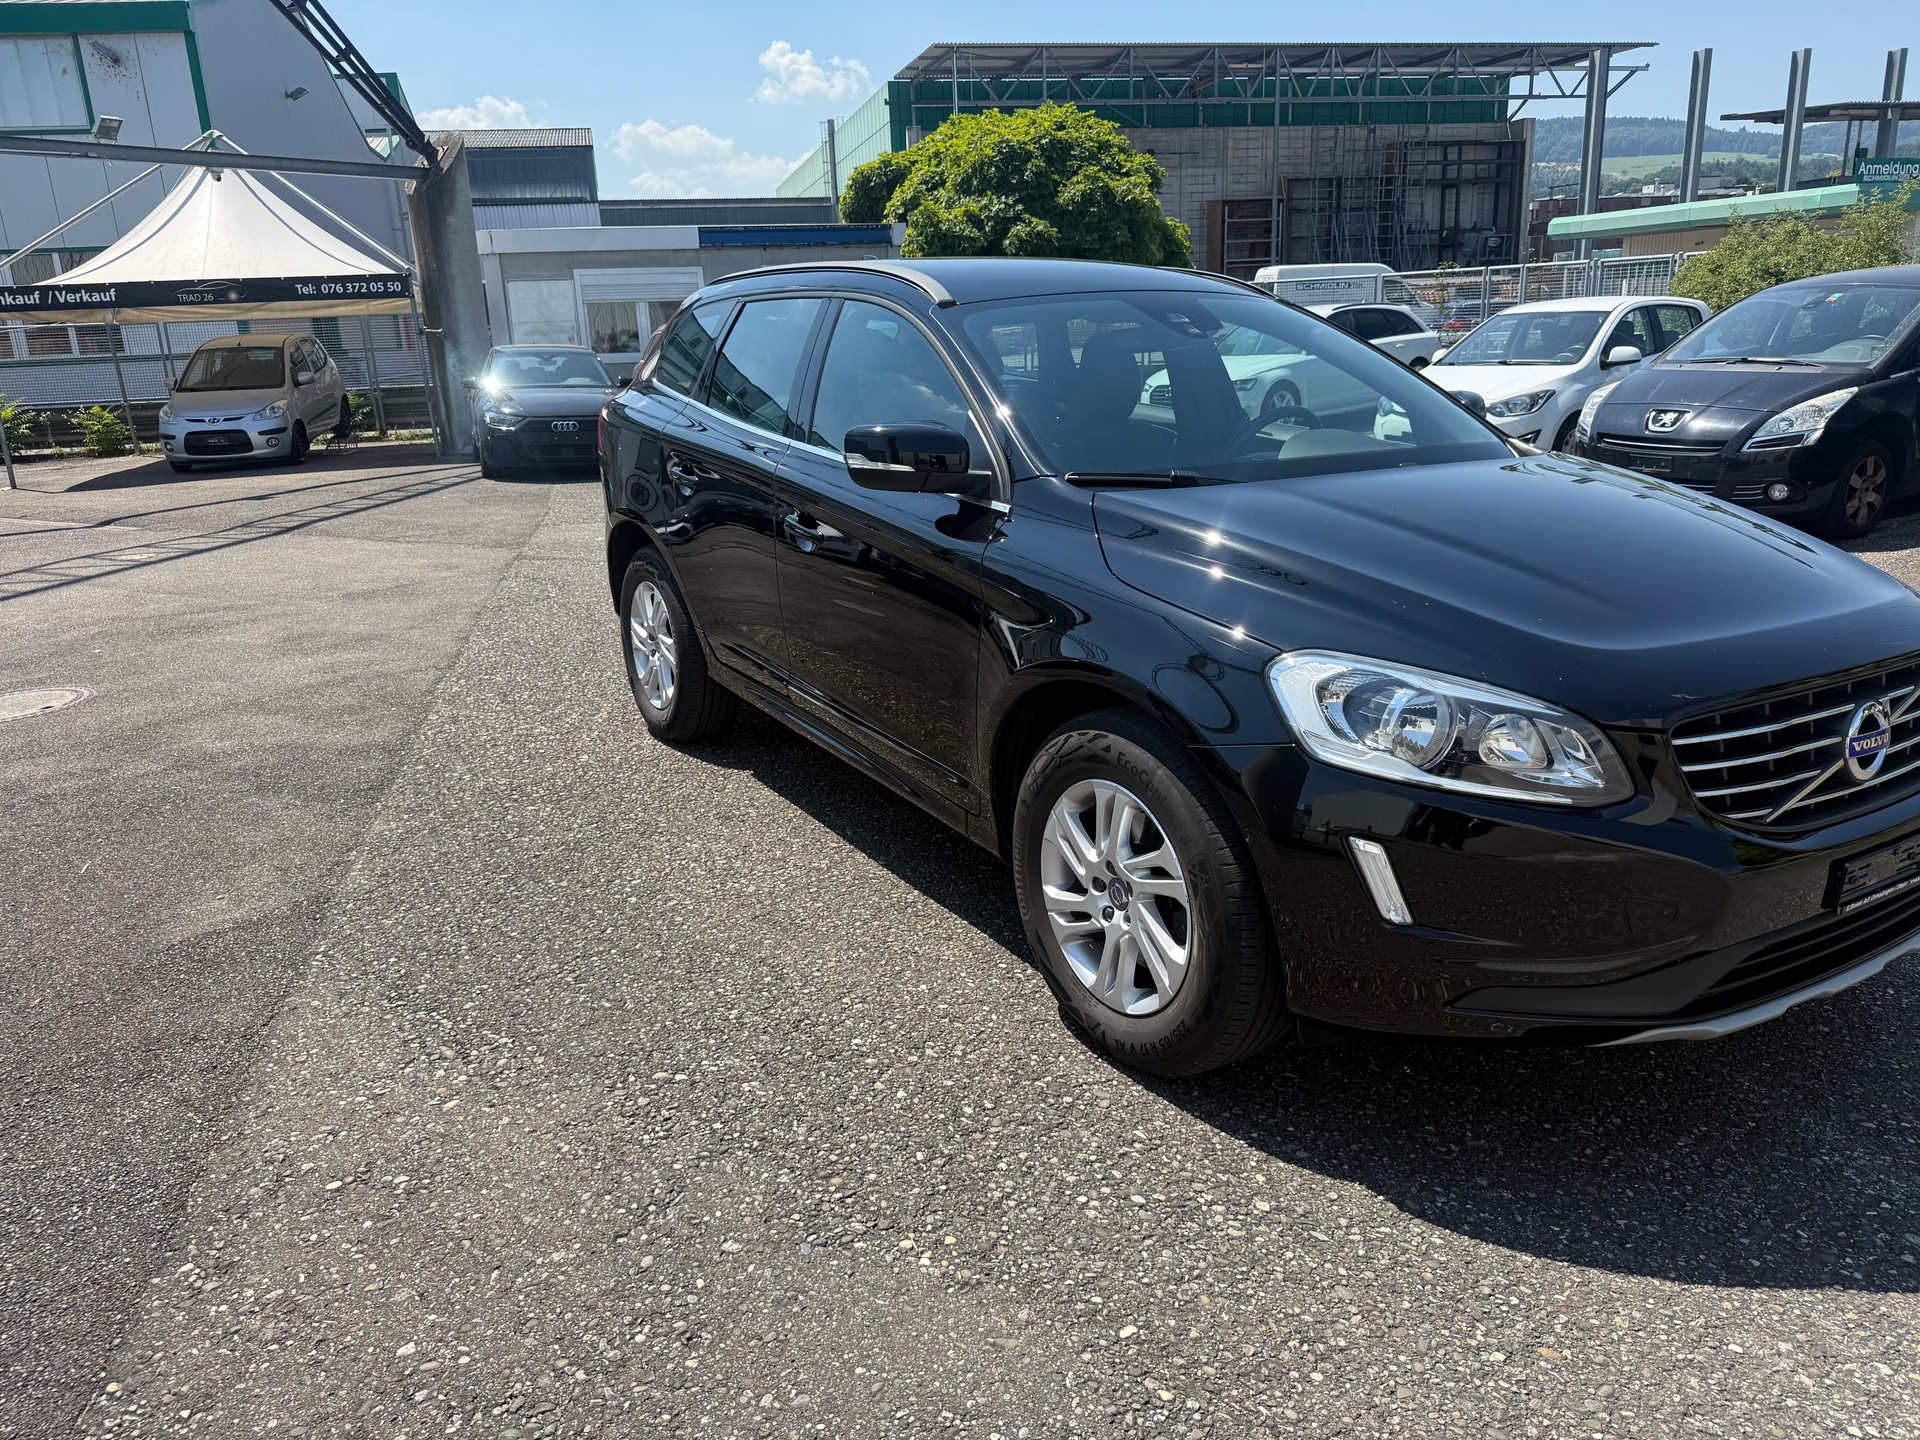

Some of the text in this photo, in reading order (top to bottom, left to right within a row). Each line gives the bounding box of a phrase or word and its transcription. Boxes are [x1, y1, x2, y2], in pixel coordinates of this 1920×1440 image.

[1857, 161, 1920, 177] Anmeldung
[295, 281, 402, 295] Tel: 076 372 05 50
[177, 293, 214, 303] TRAD 26
[1852, 732, 1889, 752] VOLVO
[1158, 1019, 1190, 1052] 235/65
[1112, 1038, 1127, 1054] XL
